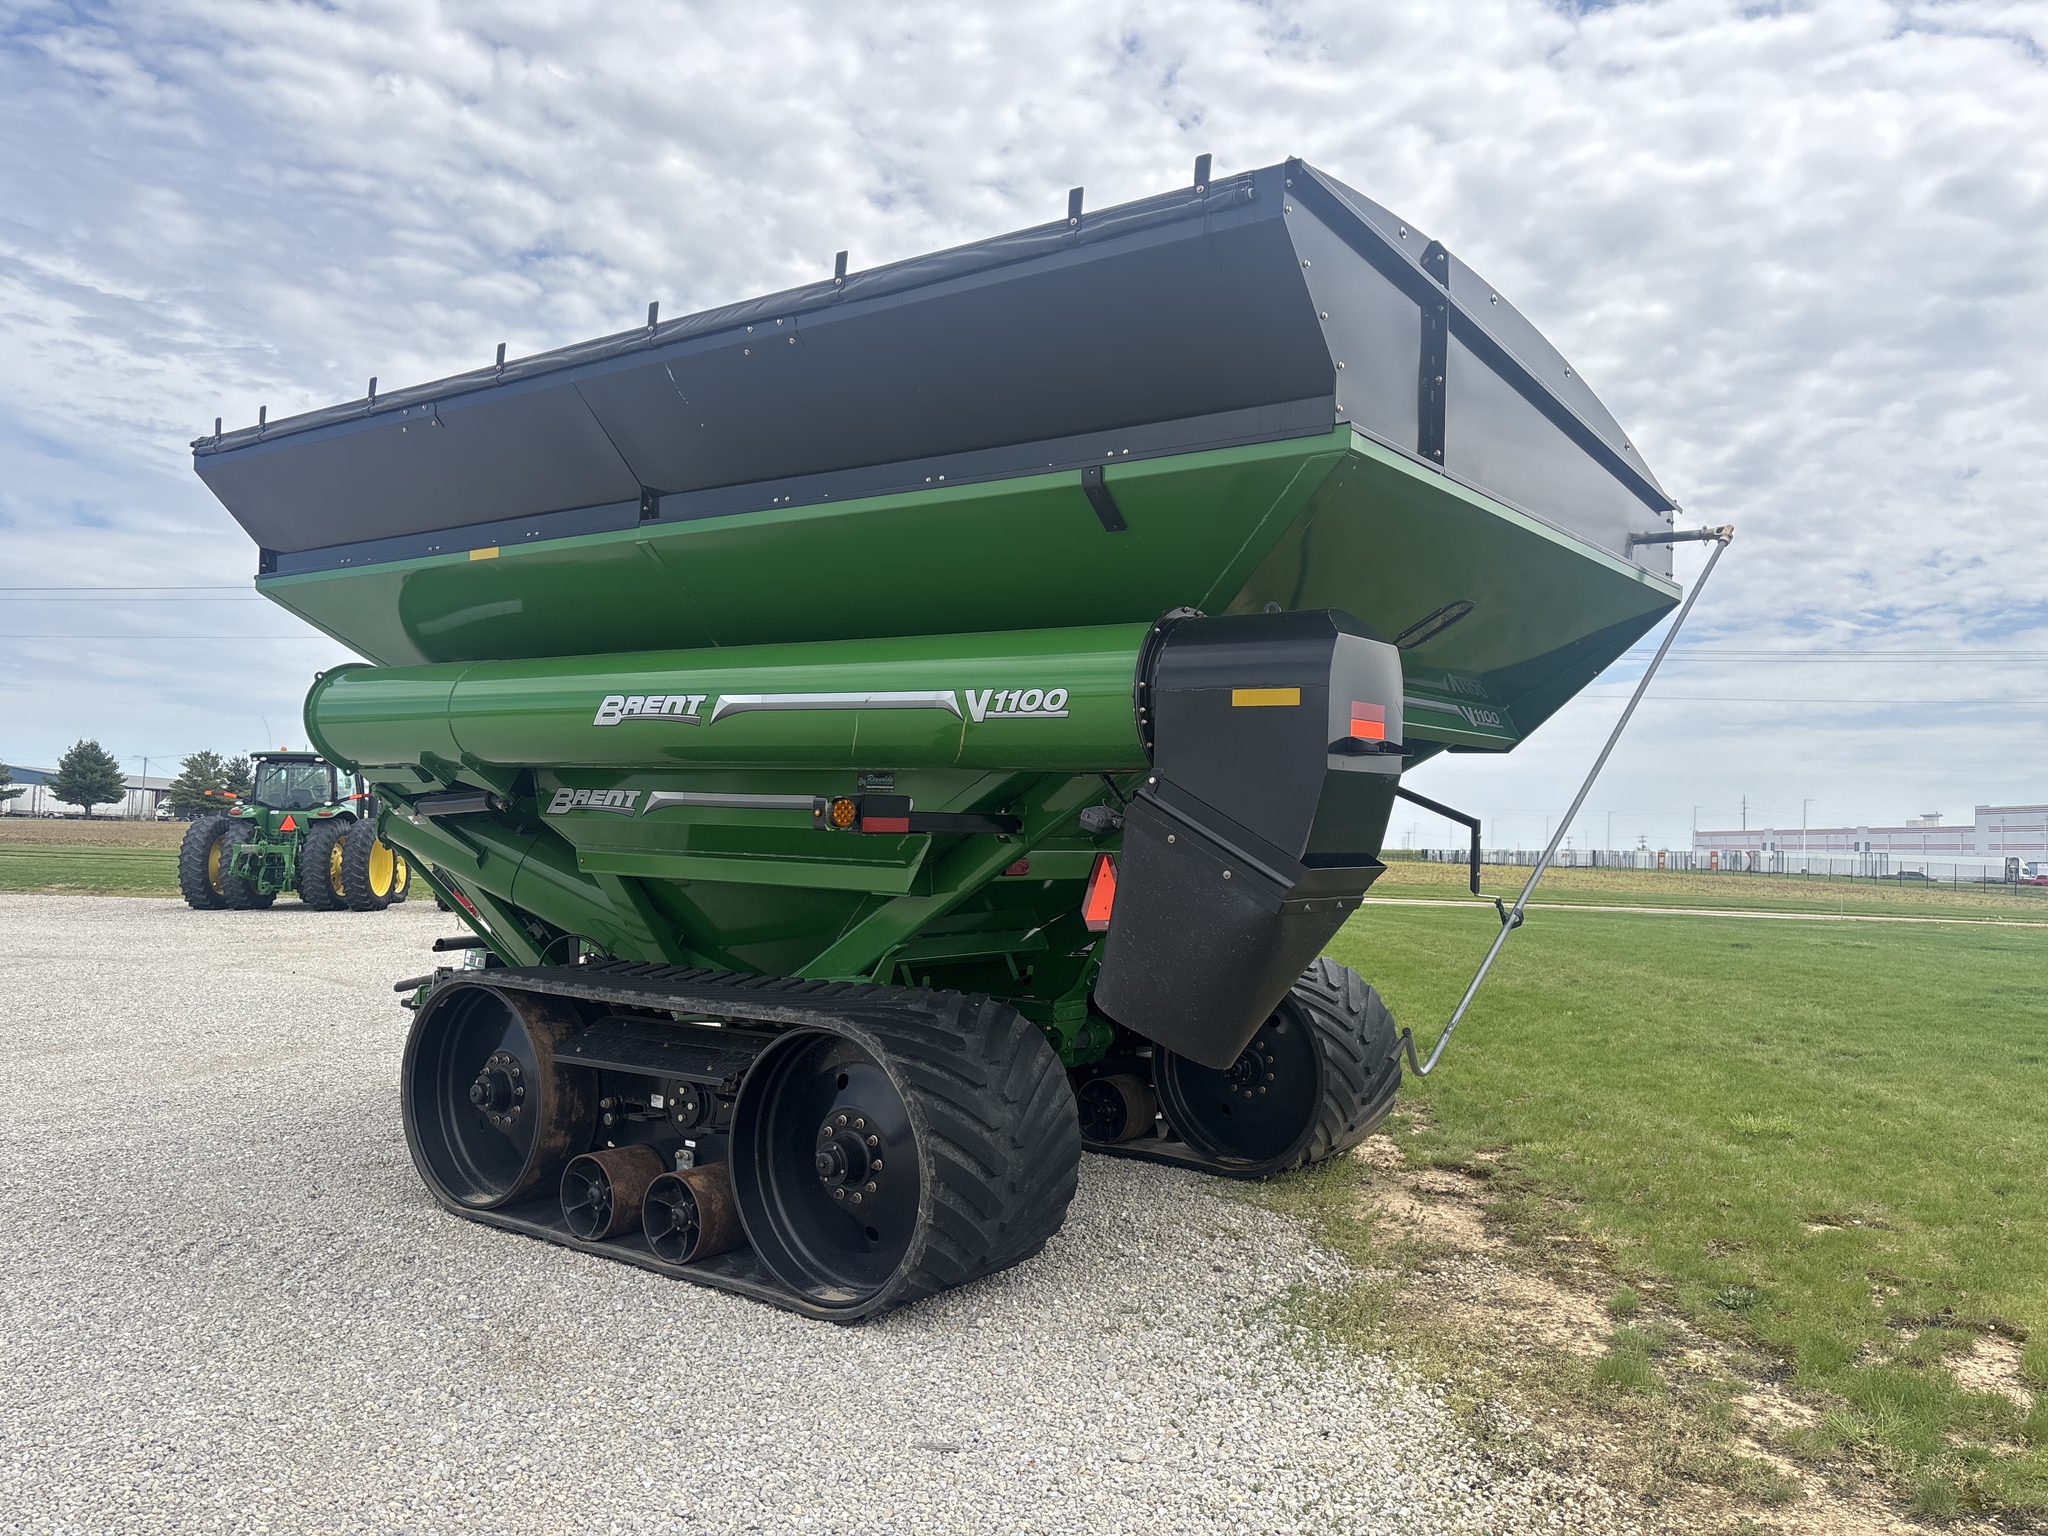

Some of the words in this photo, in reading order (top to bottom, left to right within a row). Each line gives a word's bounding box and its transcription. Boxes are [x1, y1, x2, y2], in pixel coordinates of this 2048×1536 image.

[592, 694, 708, 726] BRENT
[964, 688, 1069, 723] V1100
[1461, 705, 1502, 728] V1100
[545, 787, 642, 817] BRENT
